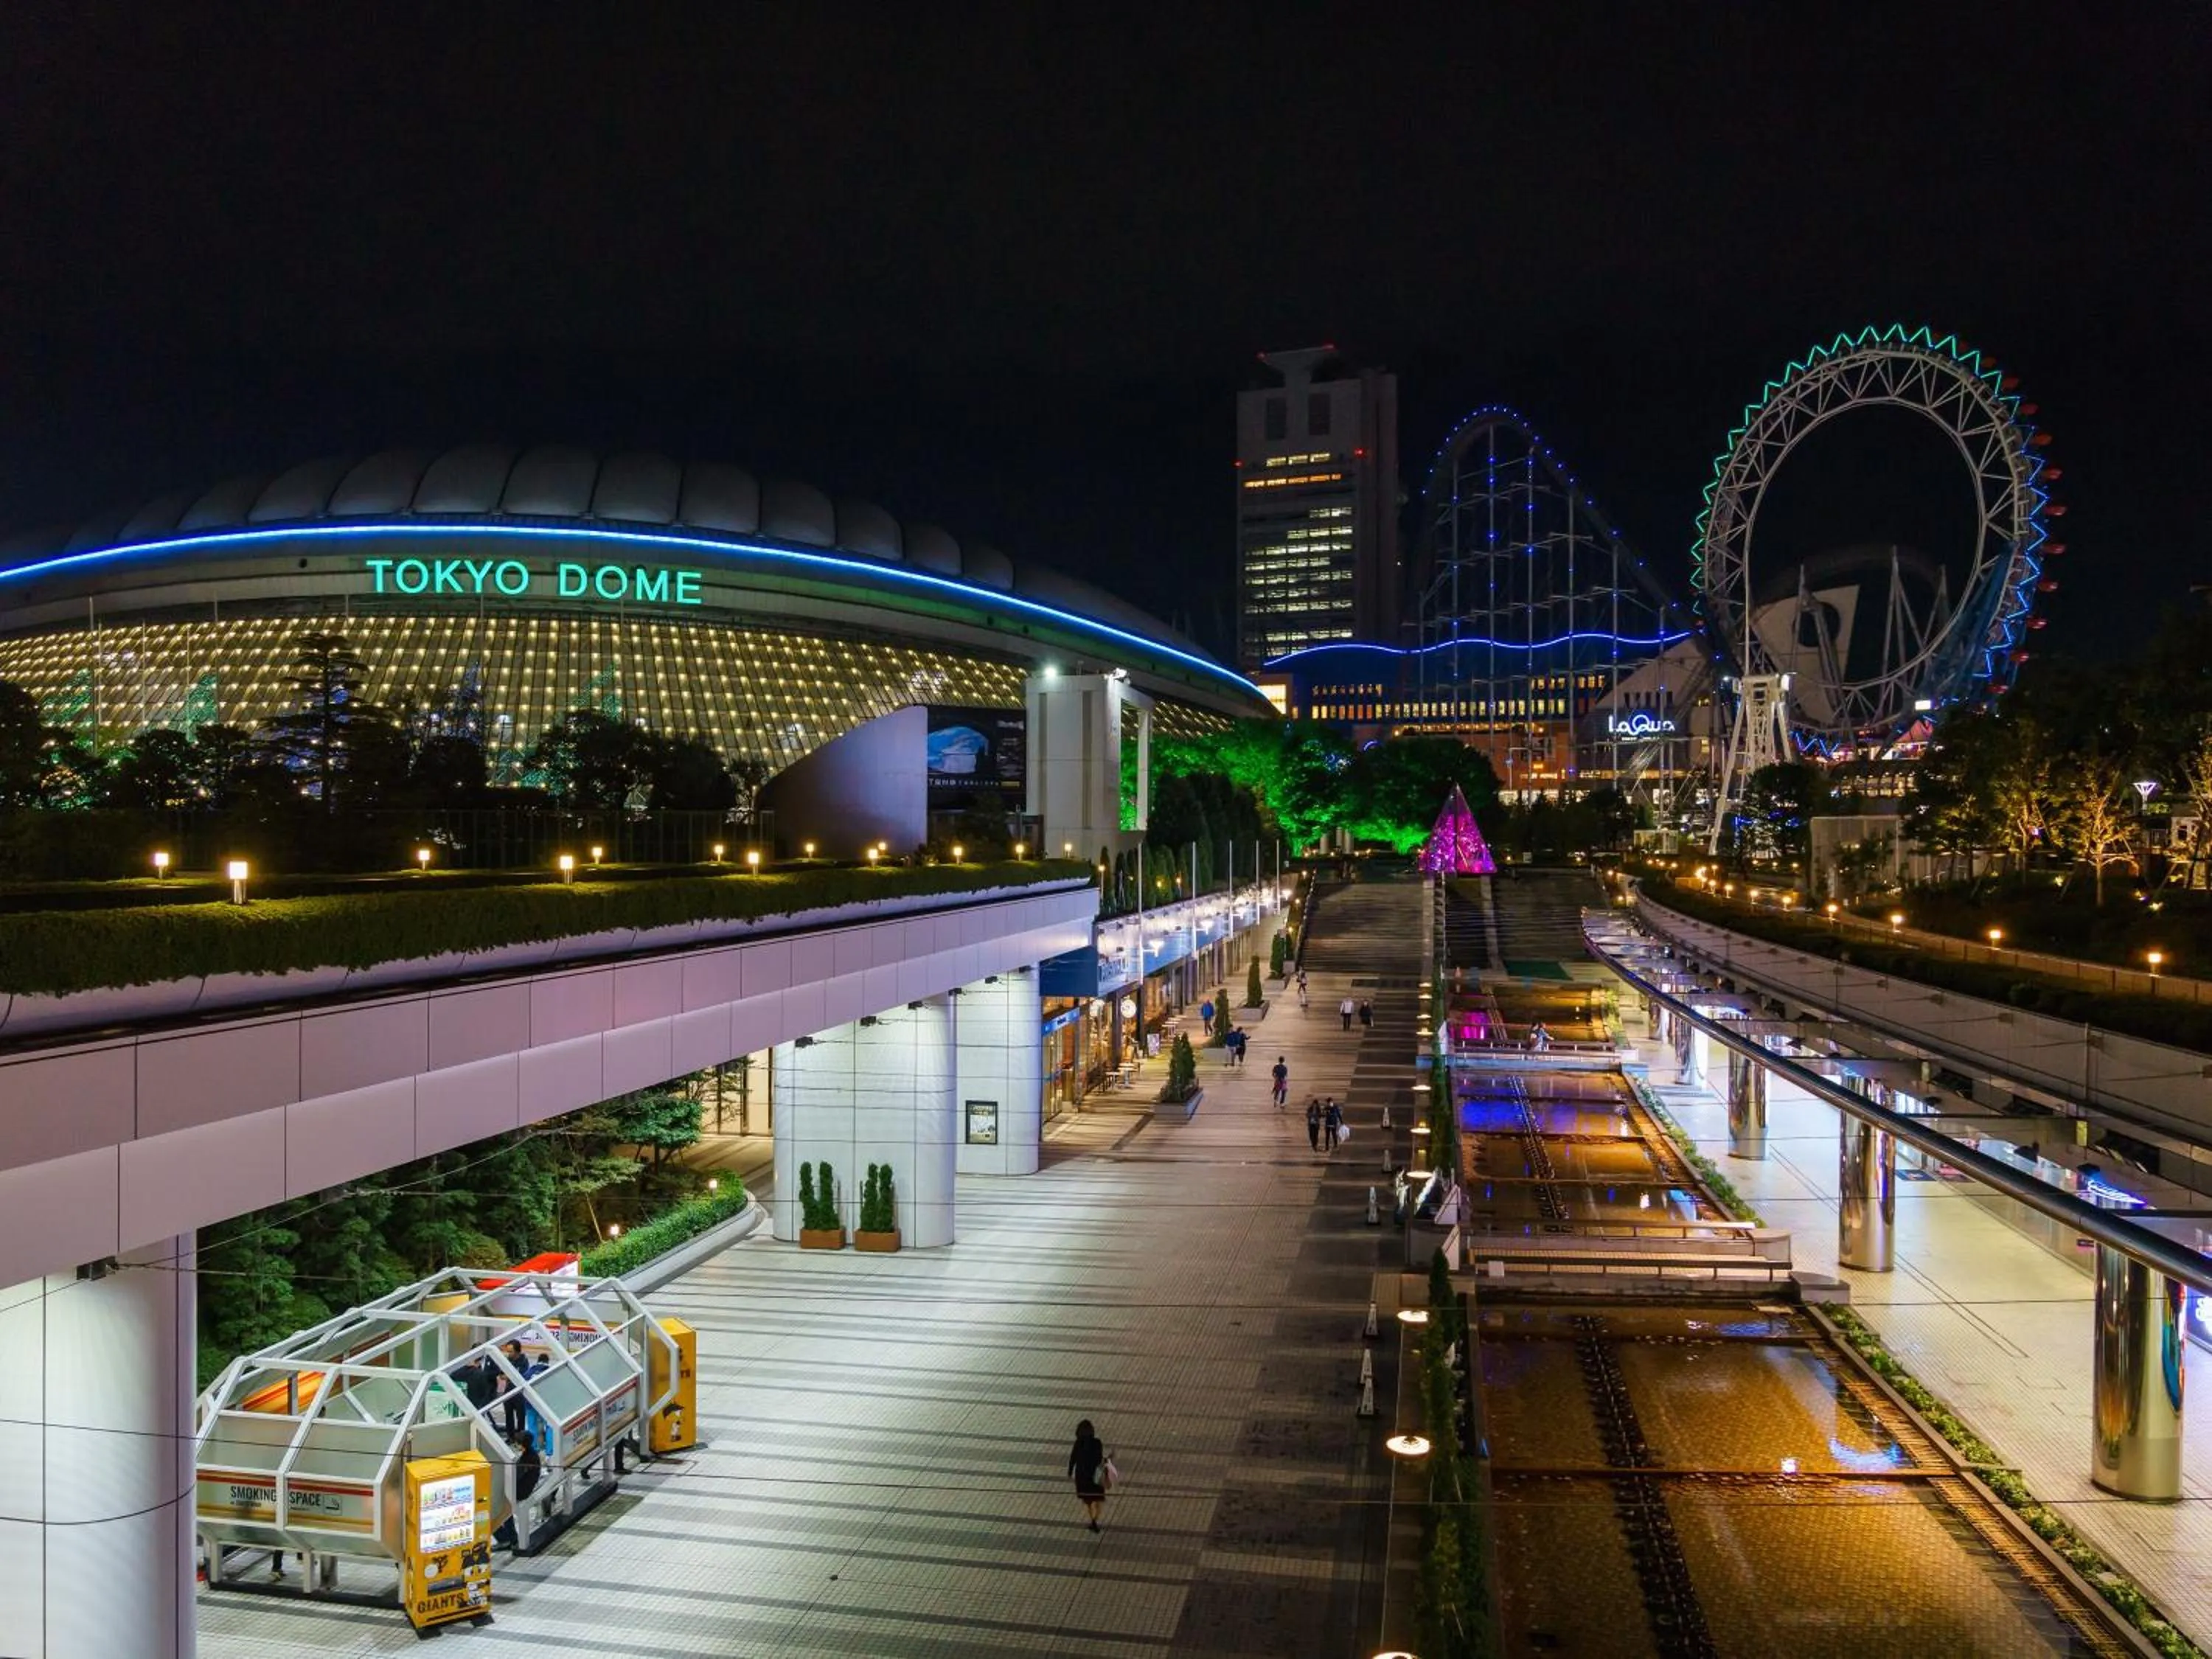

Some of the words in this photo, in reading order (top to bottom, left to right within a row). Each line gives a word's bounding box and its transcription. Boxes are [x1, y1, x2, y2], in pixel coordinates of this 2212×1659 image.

[366, 559, 529, 595] TOKYO
[558, 563, 703, 605] DOME
[1608, 714, 1675, 736] LaQua
[230, 1486, 276, 1502] SMOKING
[289, 1491, 321, 1506] SPACE
[417, 1592, 466, 1614] GIANTS
